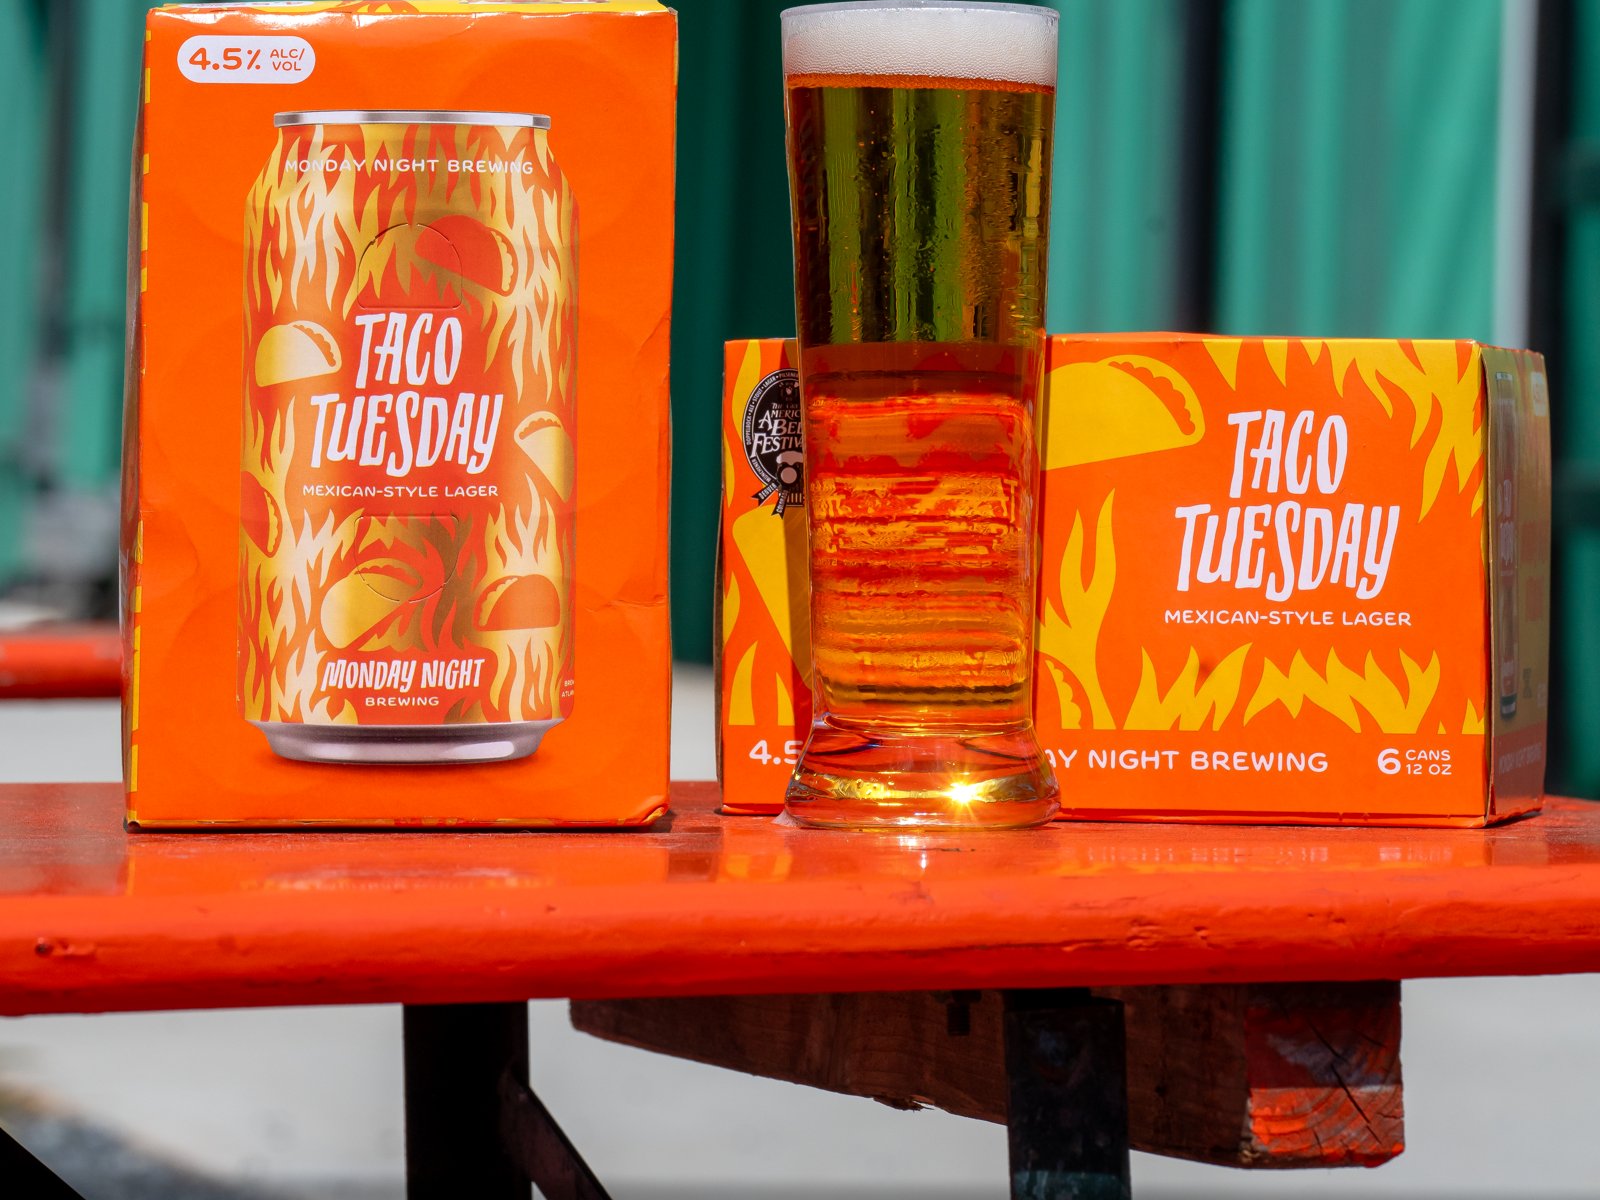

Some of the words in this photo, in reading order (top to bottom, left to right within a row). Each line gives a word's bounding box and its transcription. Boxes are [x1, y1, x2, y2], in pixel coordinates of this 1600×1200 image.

[188, 47, 261, 71] 4.5%
[269, 48, 305, 60] ALC/
[272, 61, 302, 72] VOL
[284, 158, 367, 174] MONDAY
[373, 158, 440, 173] NIGHT
[447, 159, 534, 175] BREWING
[354, 311, 463, 389] TACO
[309, 390, 504, 478] TUESDAY
[750, 432, 803, 459] FESTIV
[1227, 408, 1348, 499] TACO
[302, 484, 439, 498] MEXICAN-STYLE
[444, 485, 499, 498] LAGER
[1174, 500, 1401, 603] TUESDAY
[1164, 609, 1334, 626] MEXICAN-STYLE
[1342, 611, 1412, 627] LAGER
[319, 658, 417, 693] MONDAY
[420, 658, 486, 690] NIGHT
[365, 696, 440, 707] BREWING
[1088, 749, 1180, 770] NIGHT
[1190, 750, 1329, 773] BREWING
[1377, 747, 1402, 775] 6
[1405, 749, 1452, 761] CANS
[1406, 763, 1424, 775] 12
[1428, 763, 1453, 776] OZ
